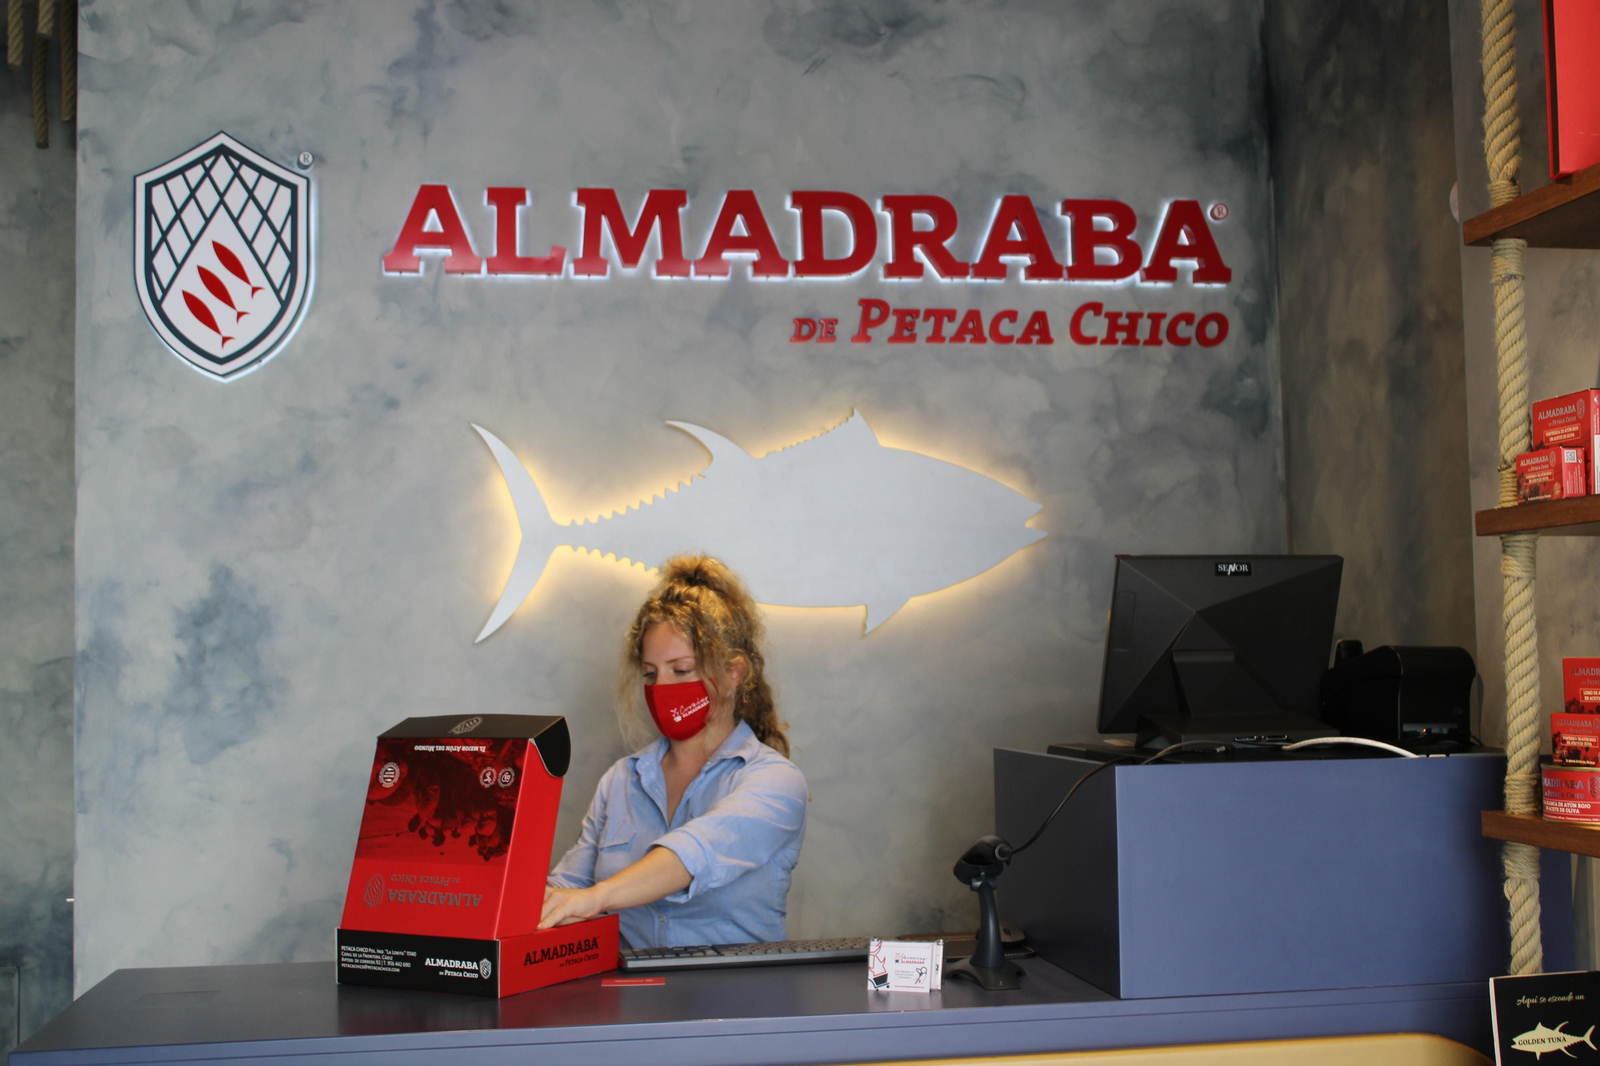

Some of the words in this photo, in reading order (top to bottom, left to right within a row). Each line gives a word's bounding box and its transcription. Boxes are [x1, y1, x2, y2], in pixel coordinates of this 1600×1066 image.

[384, 185, 1231, 281] ALMADRABA
[791, 318, 838, 343] DE
[852, 299, 1054, 344] PETACA
[1071, 302, 1228, 346] CHICO
[1538, 405, 1576, 420] ALMADRABA
[1218, 563, 1248, 576] SENOR
[391, 874, 416, 884] CHICO
[419, 876, 450, 886] PETACA
[388, 889, 483, 907] ALMADRABA
[524, 937, 598, 966] ALMADRABA
[424, 958, 478, 970] ALMADRABA
